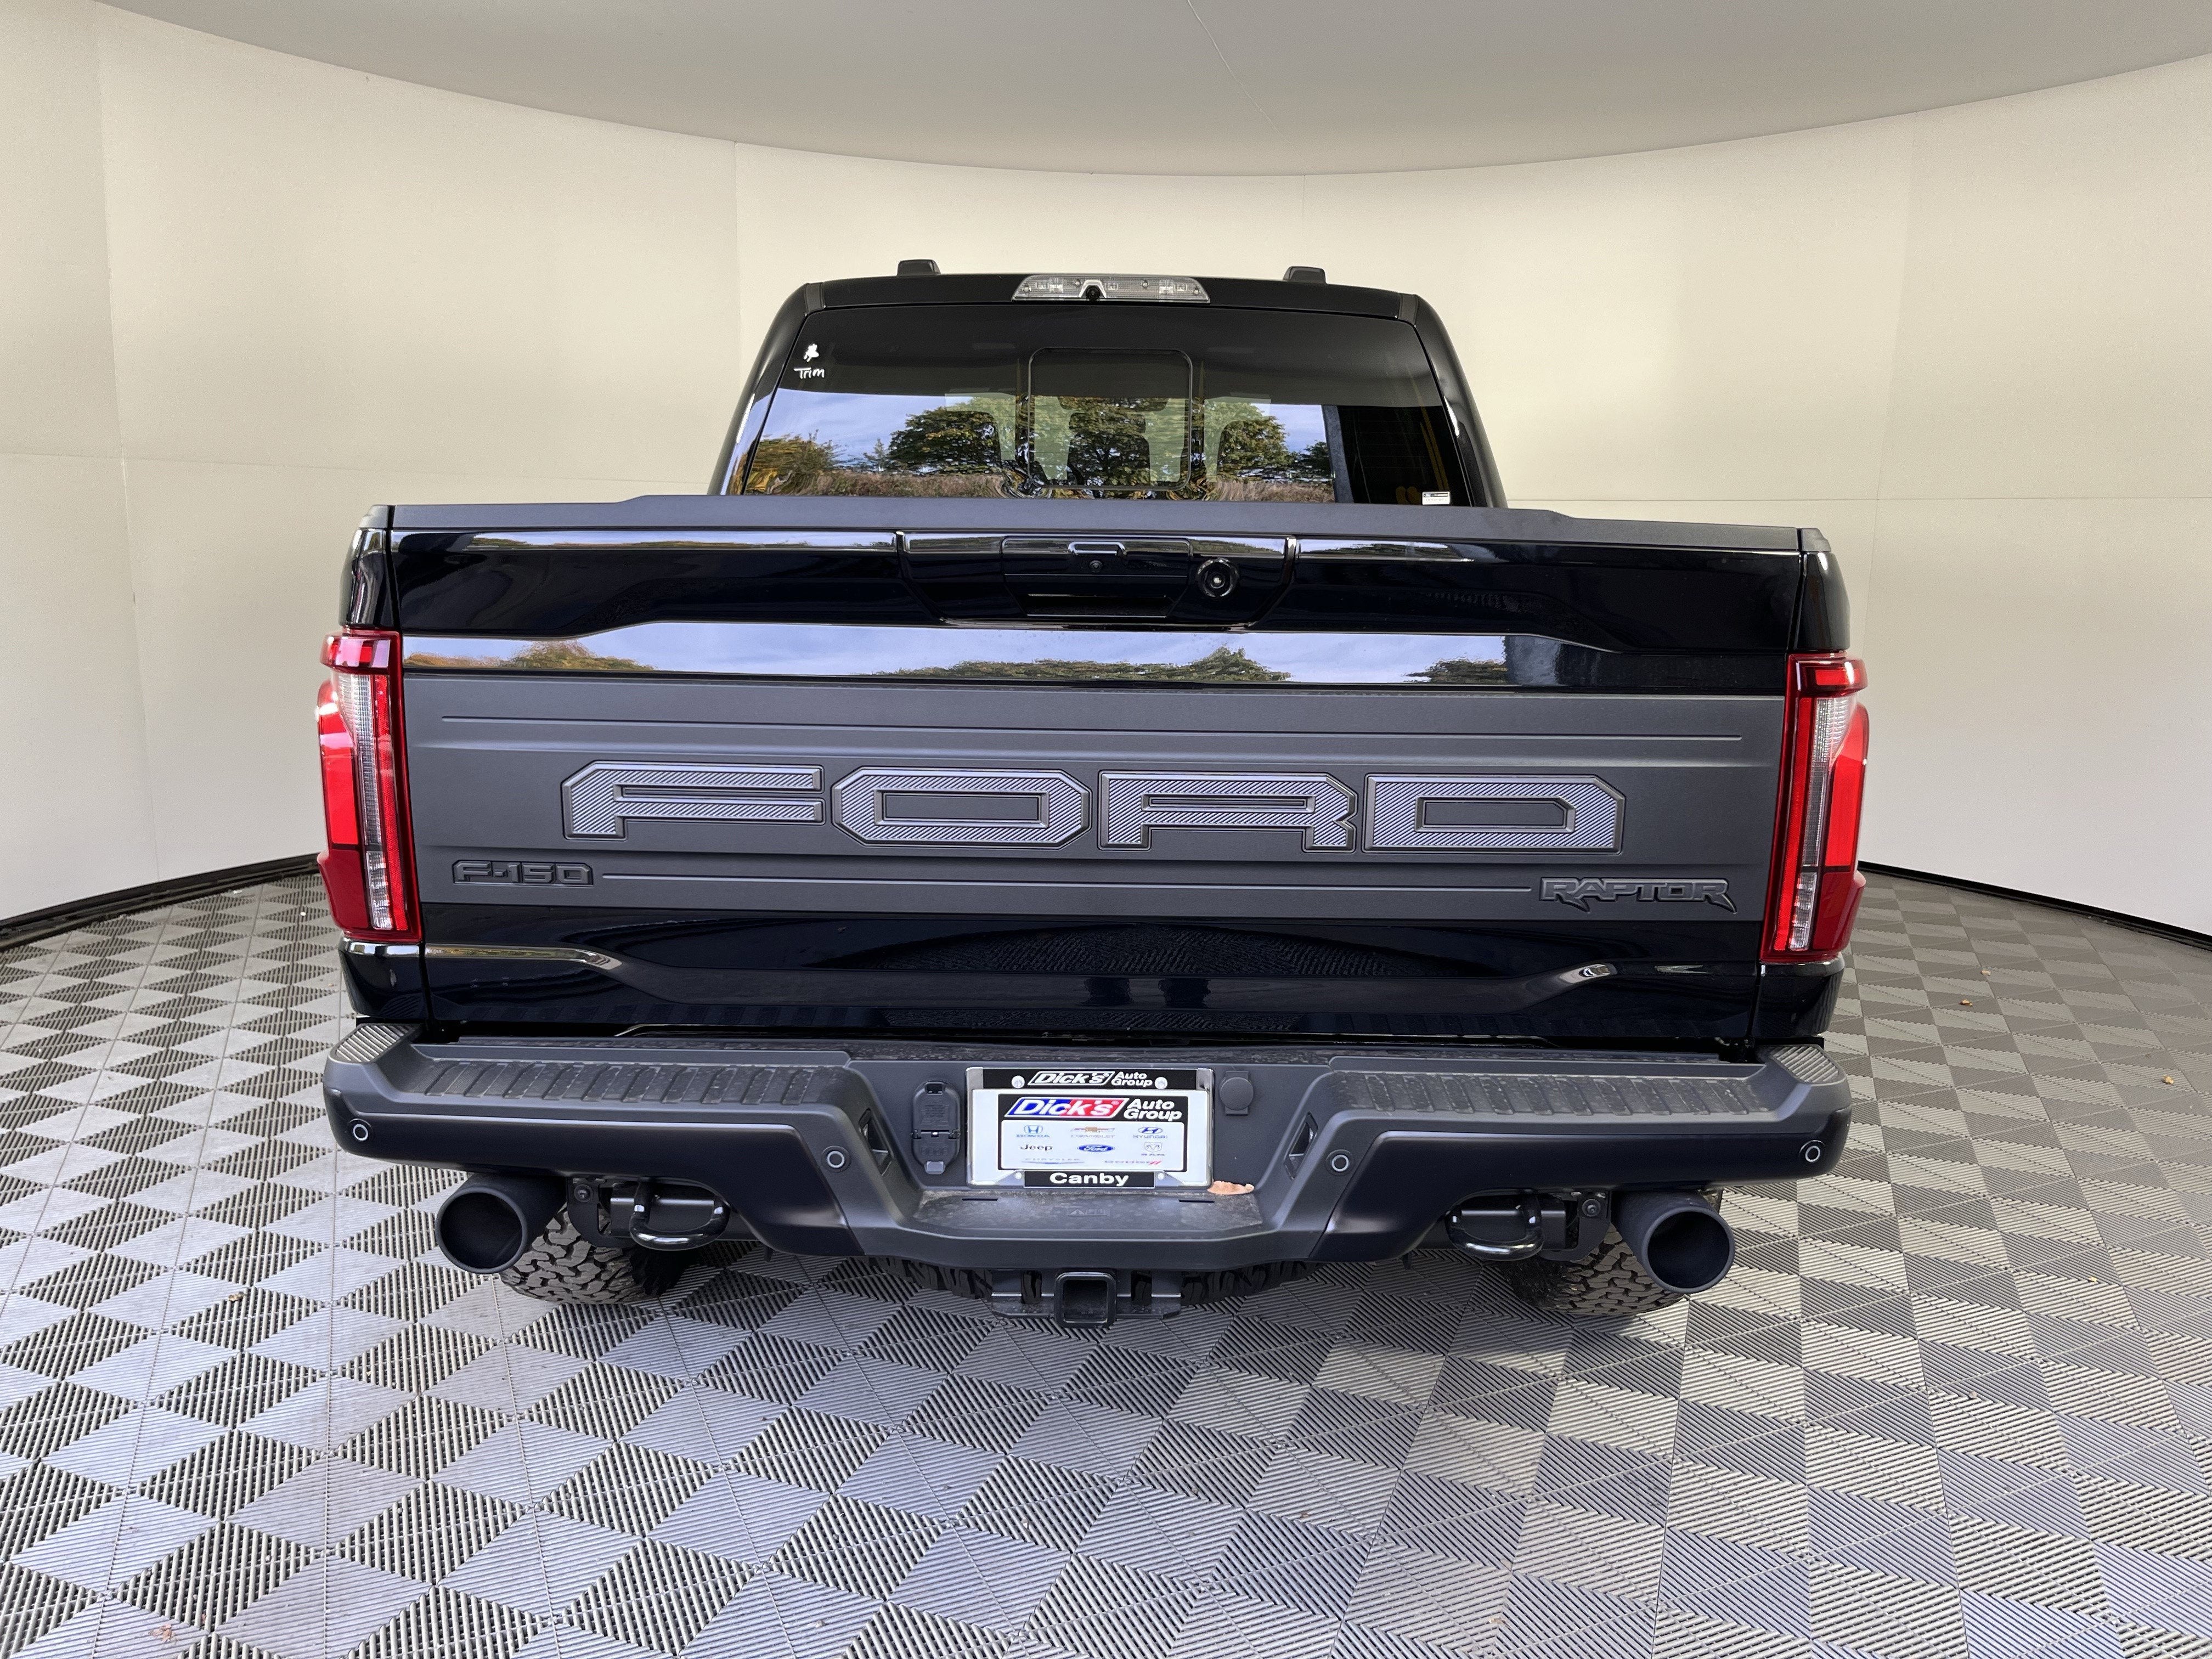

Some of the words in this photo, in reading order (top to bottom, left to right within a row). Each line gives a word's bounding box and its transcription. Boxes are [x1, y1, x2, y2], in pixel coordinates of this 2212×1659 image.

[562, 761, 1623, 854] FORD
[452, 860, 594, 887] F-150
[1539, 877, 1737, 913] RAPTOR
[1111, 1078, 1153, 1087] Group
[1114, 1071, 1147, 1080] Auto
[1127, 1098, 1175, 1110] Auto
[1124, 1108, 1182, 1122] Group
[1049, 1172, 1129, 1188] Canby
